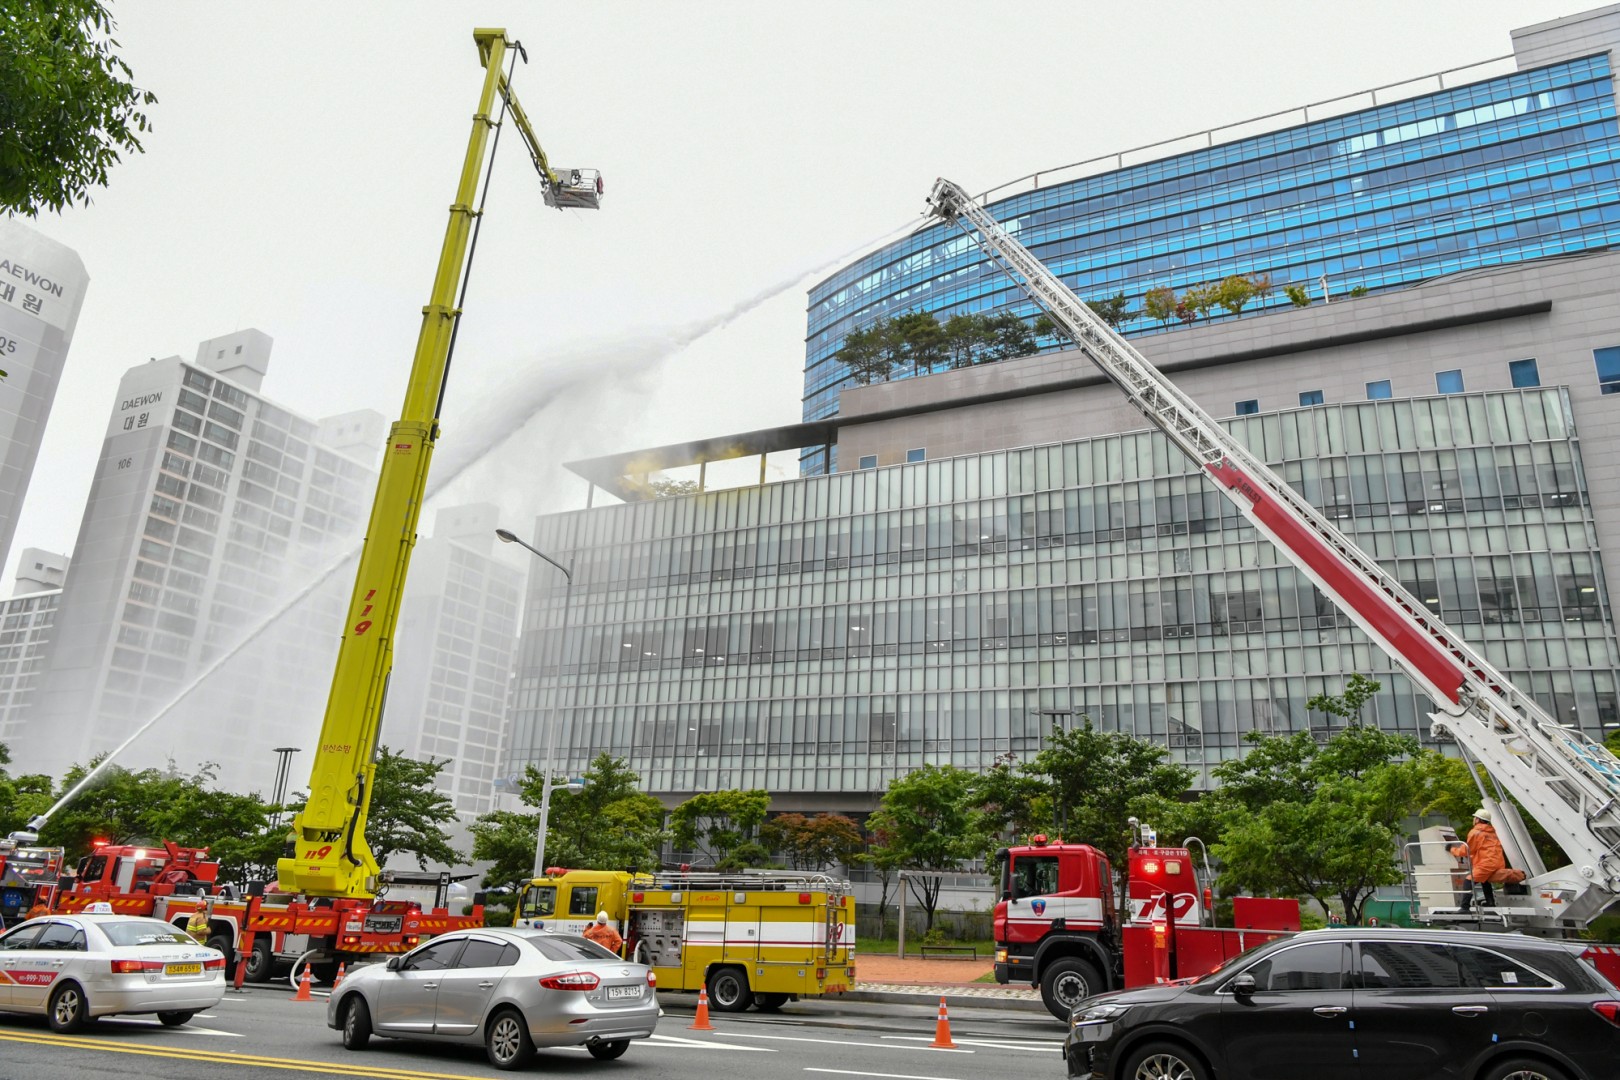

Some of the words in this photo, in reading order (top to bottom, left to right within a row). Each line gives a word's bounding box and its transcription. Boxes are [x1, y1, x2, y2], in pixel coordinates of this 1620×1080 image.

[121, 392, 162, 411] DAEWON
[118, 458, 132, 470] 106
[355, 589, 376, 636] 119
[304, 845, 332, 860] 119
